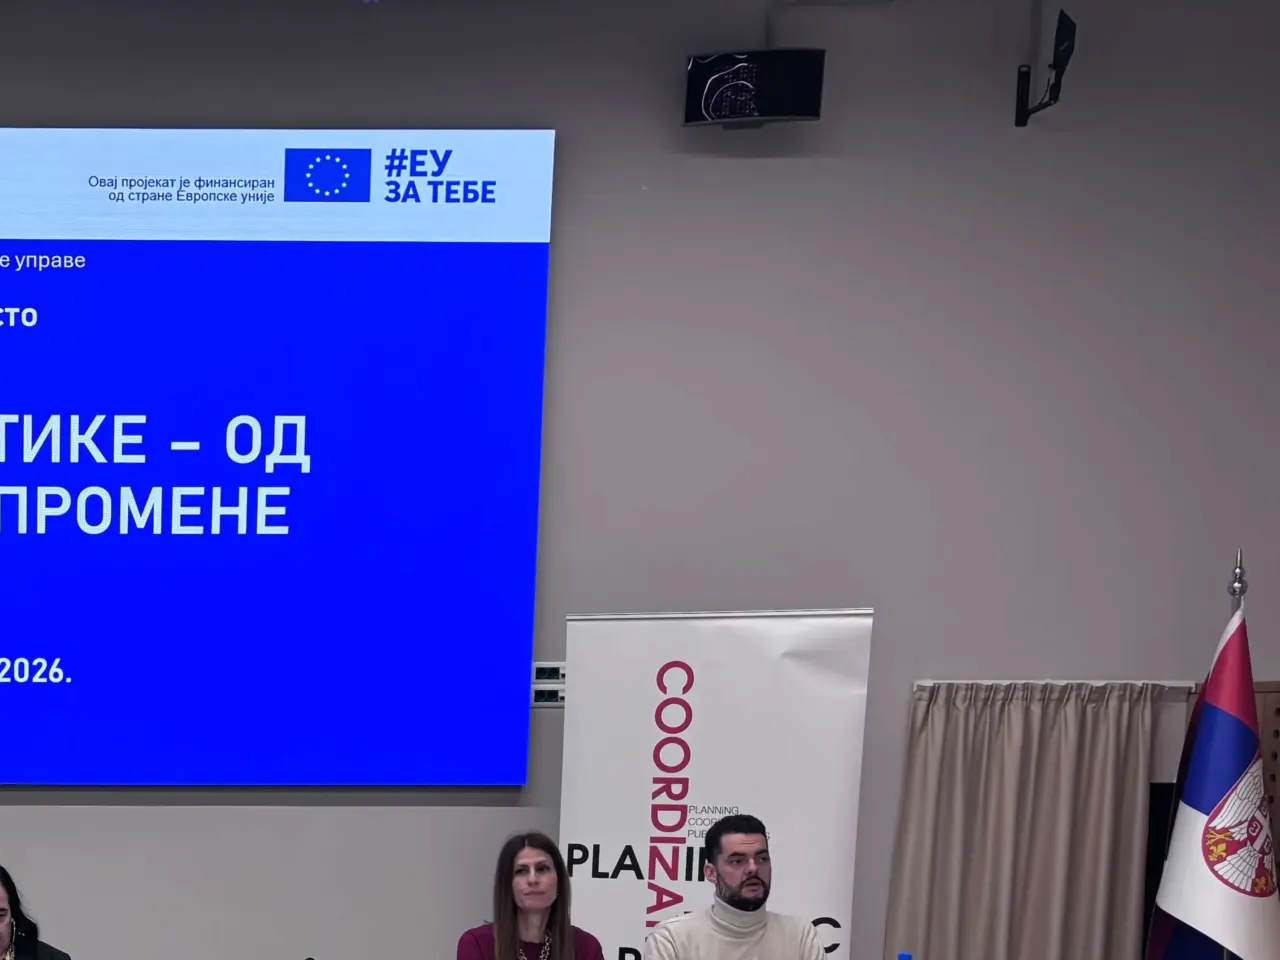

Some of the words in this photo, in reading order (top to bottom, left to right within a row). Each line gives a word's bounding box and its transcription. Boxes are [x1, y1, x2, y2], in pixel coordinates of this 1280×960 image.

[385, 148, 453, 177] #ЕУ
[88, 175, 118, 189] Овај
[121, 177, 176, 189] пројекат
[179, 176, 190, 190] је
[194, 177, 275, 190] финансиран
[108, 192, 125, 202] од
[128, 192, 173, 203] стране
[176, 190, 237, 204] Европске
[241, 191, 275, 204] уније
[384, 180, 421, 203] ЗА
[427, 180, 497, 203] ТЕБЕ
[15, 254, 86, 271] управе
[225, 414, 311, 474] ОД
[688, 805, 739, 815] PLANNING
